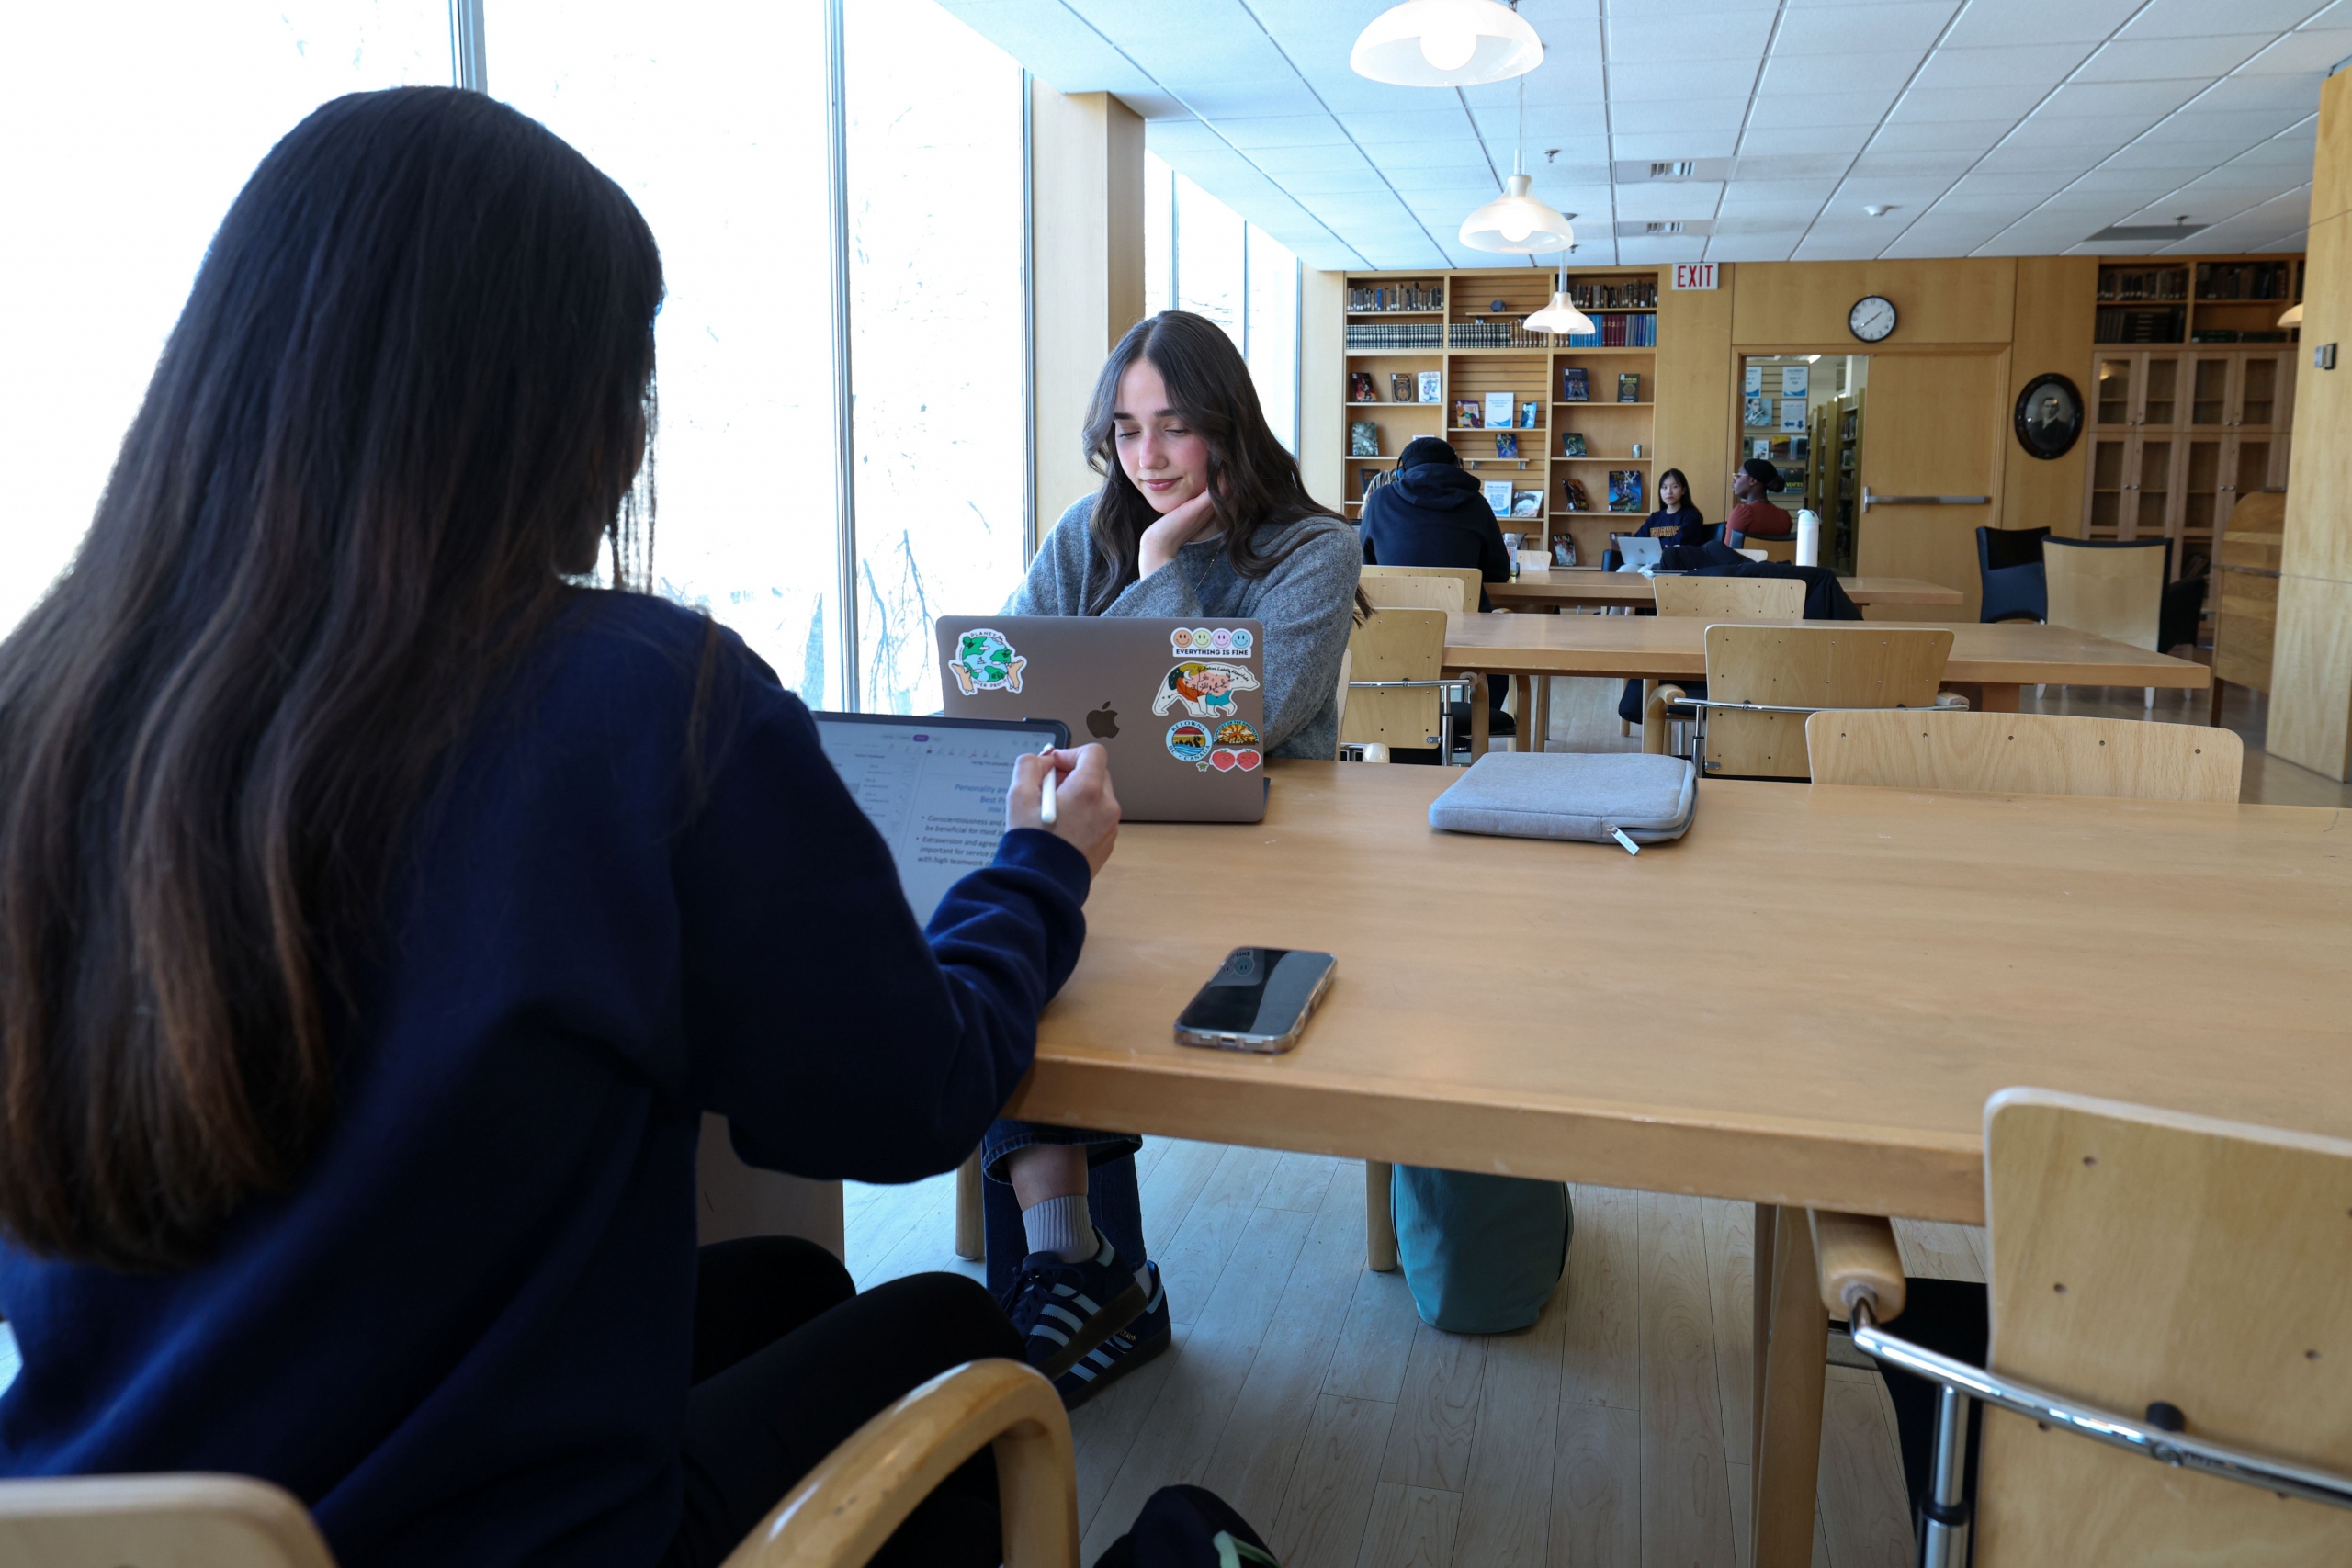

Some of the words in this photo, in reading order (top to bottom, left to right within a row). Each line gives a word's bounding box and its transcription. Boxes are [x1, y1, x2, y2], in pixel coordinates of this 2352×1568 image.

[1677, 265, 1713, 288] EXIT
[989, 679, 1008, 687] PROFIT
[1171, 720, 1205, 732] KELOWNA
[1168, 745, 1175, 755] BC
[1183, 745, 1210, 761] CANADA
[955, 784, 995, 793] Personality
[980, 795, 996, 804] Best
[928, 815, 988, 826] Conscientiousness
[935, 826, 967, 834] beneficial
[922, 836, 963, 845] Extraversion
[920, 846, 954, 855] important
[966, 850, 989, 858] service
[934, 856, 948, 865] high
[950, 858, 984, 867] teamwork
